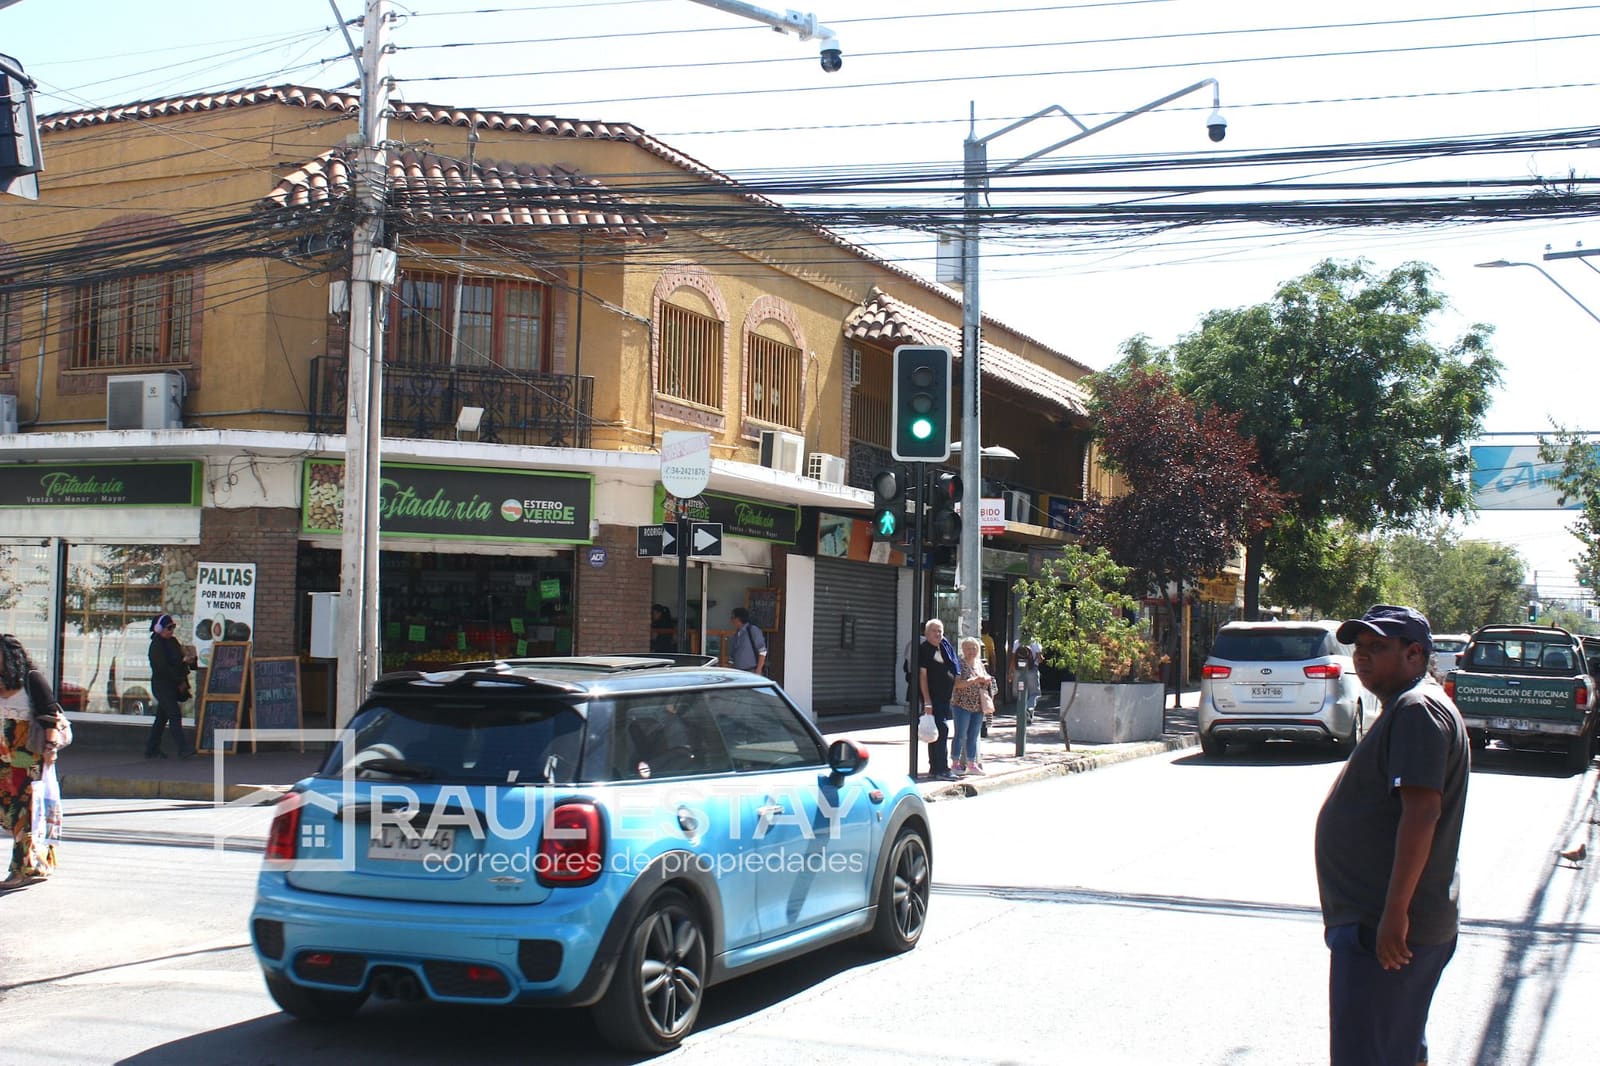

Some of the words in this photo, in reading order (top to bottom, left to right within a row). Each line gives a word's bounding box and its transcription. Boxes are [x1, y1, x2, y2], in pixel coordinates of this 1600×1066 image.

[524, 500, 563, 509] ESTERO
[524, 506, 575, 520] VERDE
[199, 567, 253, 586] PALTAS
[201, 590, 217, 599] POR
[219, 590, 246, 600] MAYOR
[207, 601, 212, 609] Y
[213, 601, 241, 609] MENOR
[1521, 689, 1532, 697] DE
[1533, 690, 1569, 699] PISCINAS
